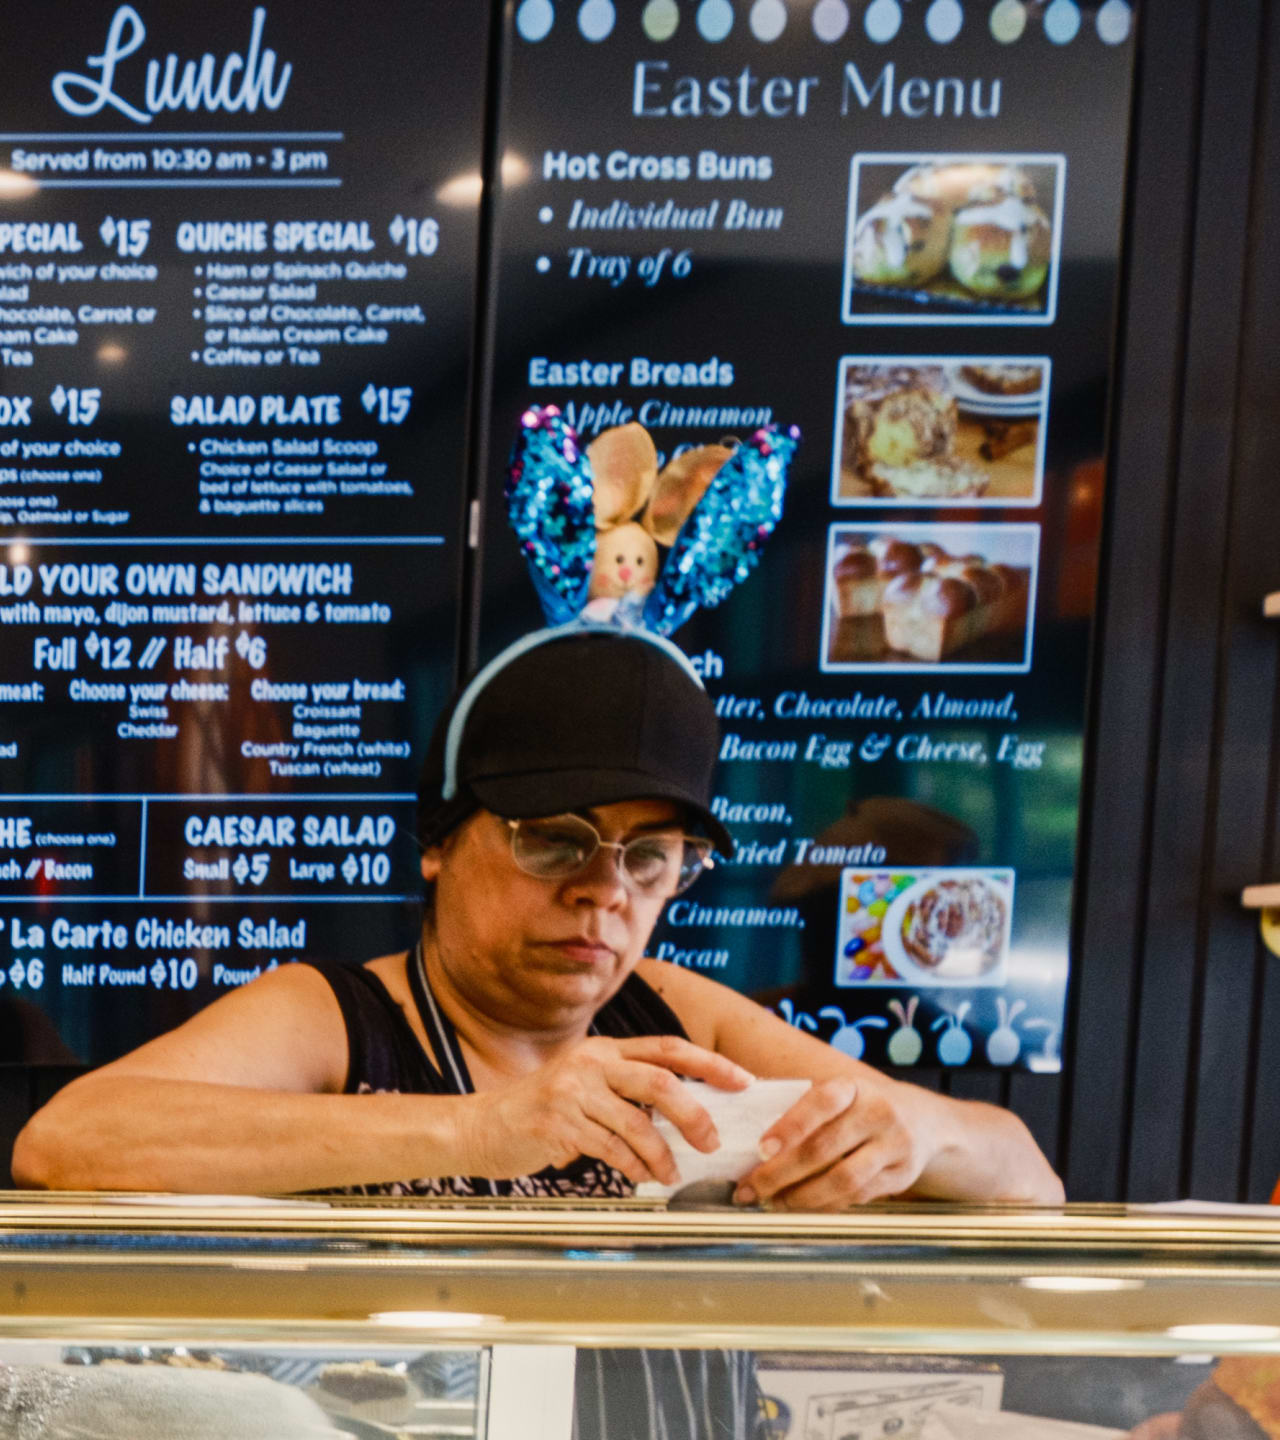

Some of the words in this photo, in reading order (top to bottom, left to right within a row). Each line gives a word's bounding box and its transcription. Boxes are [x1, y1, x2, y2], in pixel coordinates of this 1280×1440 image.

[51, 4, 293, 125] Lunch
[632, 61, 819, 118] Easter
[841, 61, 1002, 118] Menu
[8, 148, 90, 174] Served
[92, 148, 148, 171] from
[151, 148, 213, 171] 10:30
[214, 151, 253, 171] am
[271, 147, 286, 171] 3
[288, 151, 329, 174] pm
[542, 150, 601, 181] Hot
[605, 150, 691, 181] Cross
[696, 150, 773, 181] Buns
[567, 199, 719, 230] Individual
[723, 199, 784, 230] Bun
[98, 215, 152, 258] $15
[176, 221, 268, 253] QUICHE
[273, 221, 376, 253] SPECIAL
[388, 214, 440, 257] $16
[568, 247, 631, 287] Tray
[637, 247, 672, 287] of
[671, 248, 692, 277] 6
[528, 356, 625, 387] Easter
[629, 356, 735, 387] Breads
[49, 384, 102, 427] $15
[170, 394, 257, 426] SALAD
[259, 394, 342, 426] PLATE
[360, 383, 414, 425] $15
[38, 563, 120, 597] YOUR
[125, 563, 197, 597] OWN
[202, 562, 353, 596] SANDWICH
[33, 636, 78, 671] Full
[83, 629, 133, 671] $12
[173, 635, 230, 670] Half
[234, 630, 267, 670] $6
[773, 691, 903, 721] Chocolate,
[911, 691, 1018, 721] Almond,
[718, 733, 798, 761] Bacon
[803, 733, 853, 769] Egg
[858, 732, 892, 762] &
[895, 734, 988, 764] Cheese,
[996, 734, 1047, 770] Egg
[183, 815, 297, 847] CAESAR
[302, 814, 397, 847] SALAD
[183, 857, 230, 881] Small
[228, 852, 271, 886] $5
[289, 857, 336, 883] Large
[340, 852, 391, 886] $10
[794, 838, 890, 869] Tomato
[664, 900, 805, 929] Cinnamon,
[10, 917, 46, 950] La
[50, 917, 129, 950] Carte
[134, 917, 231, 950] Chicken
[236, 917, 307, 950] Salad
